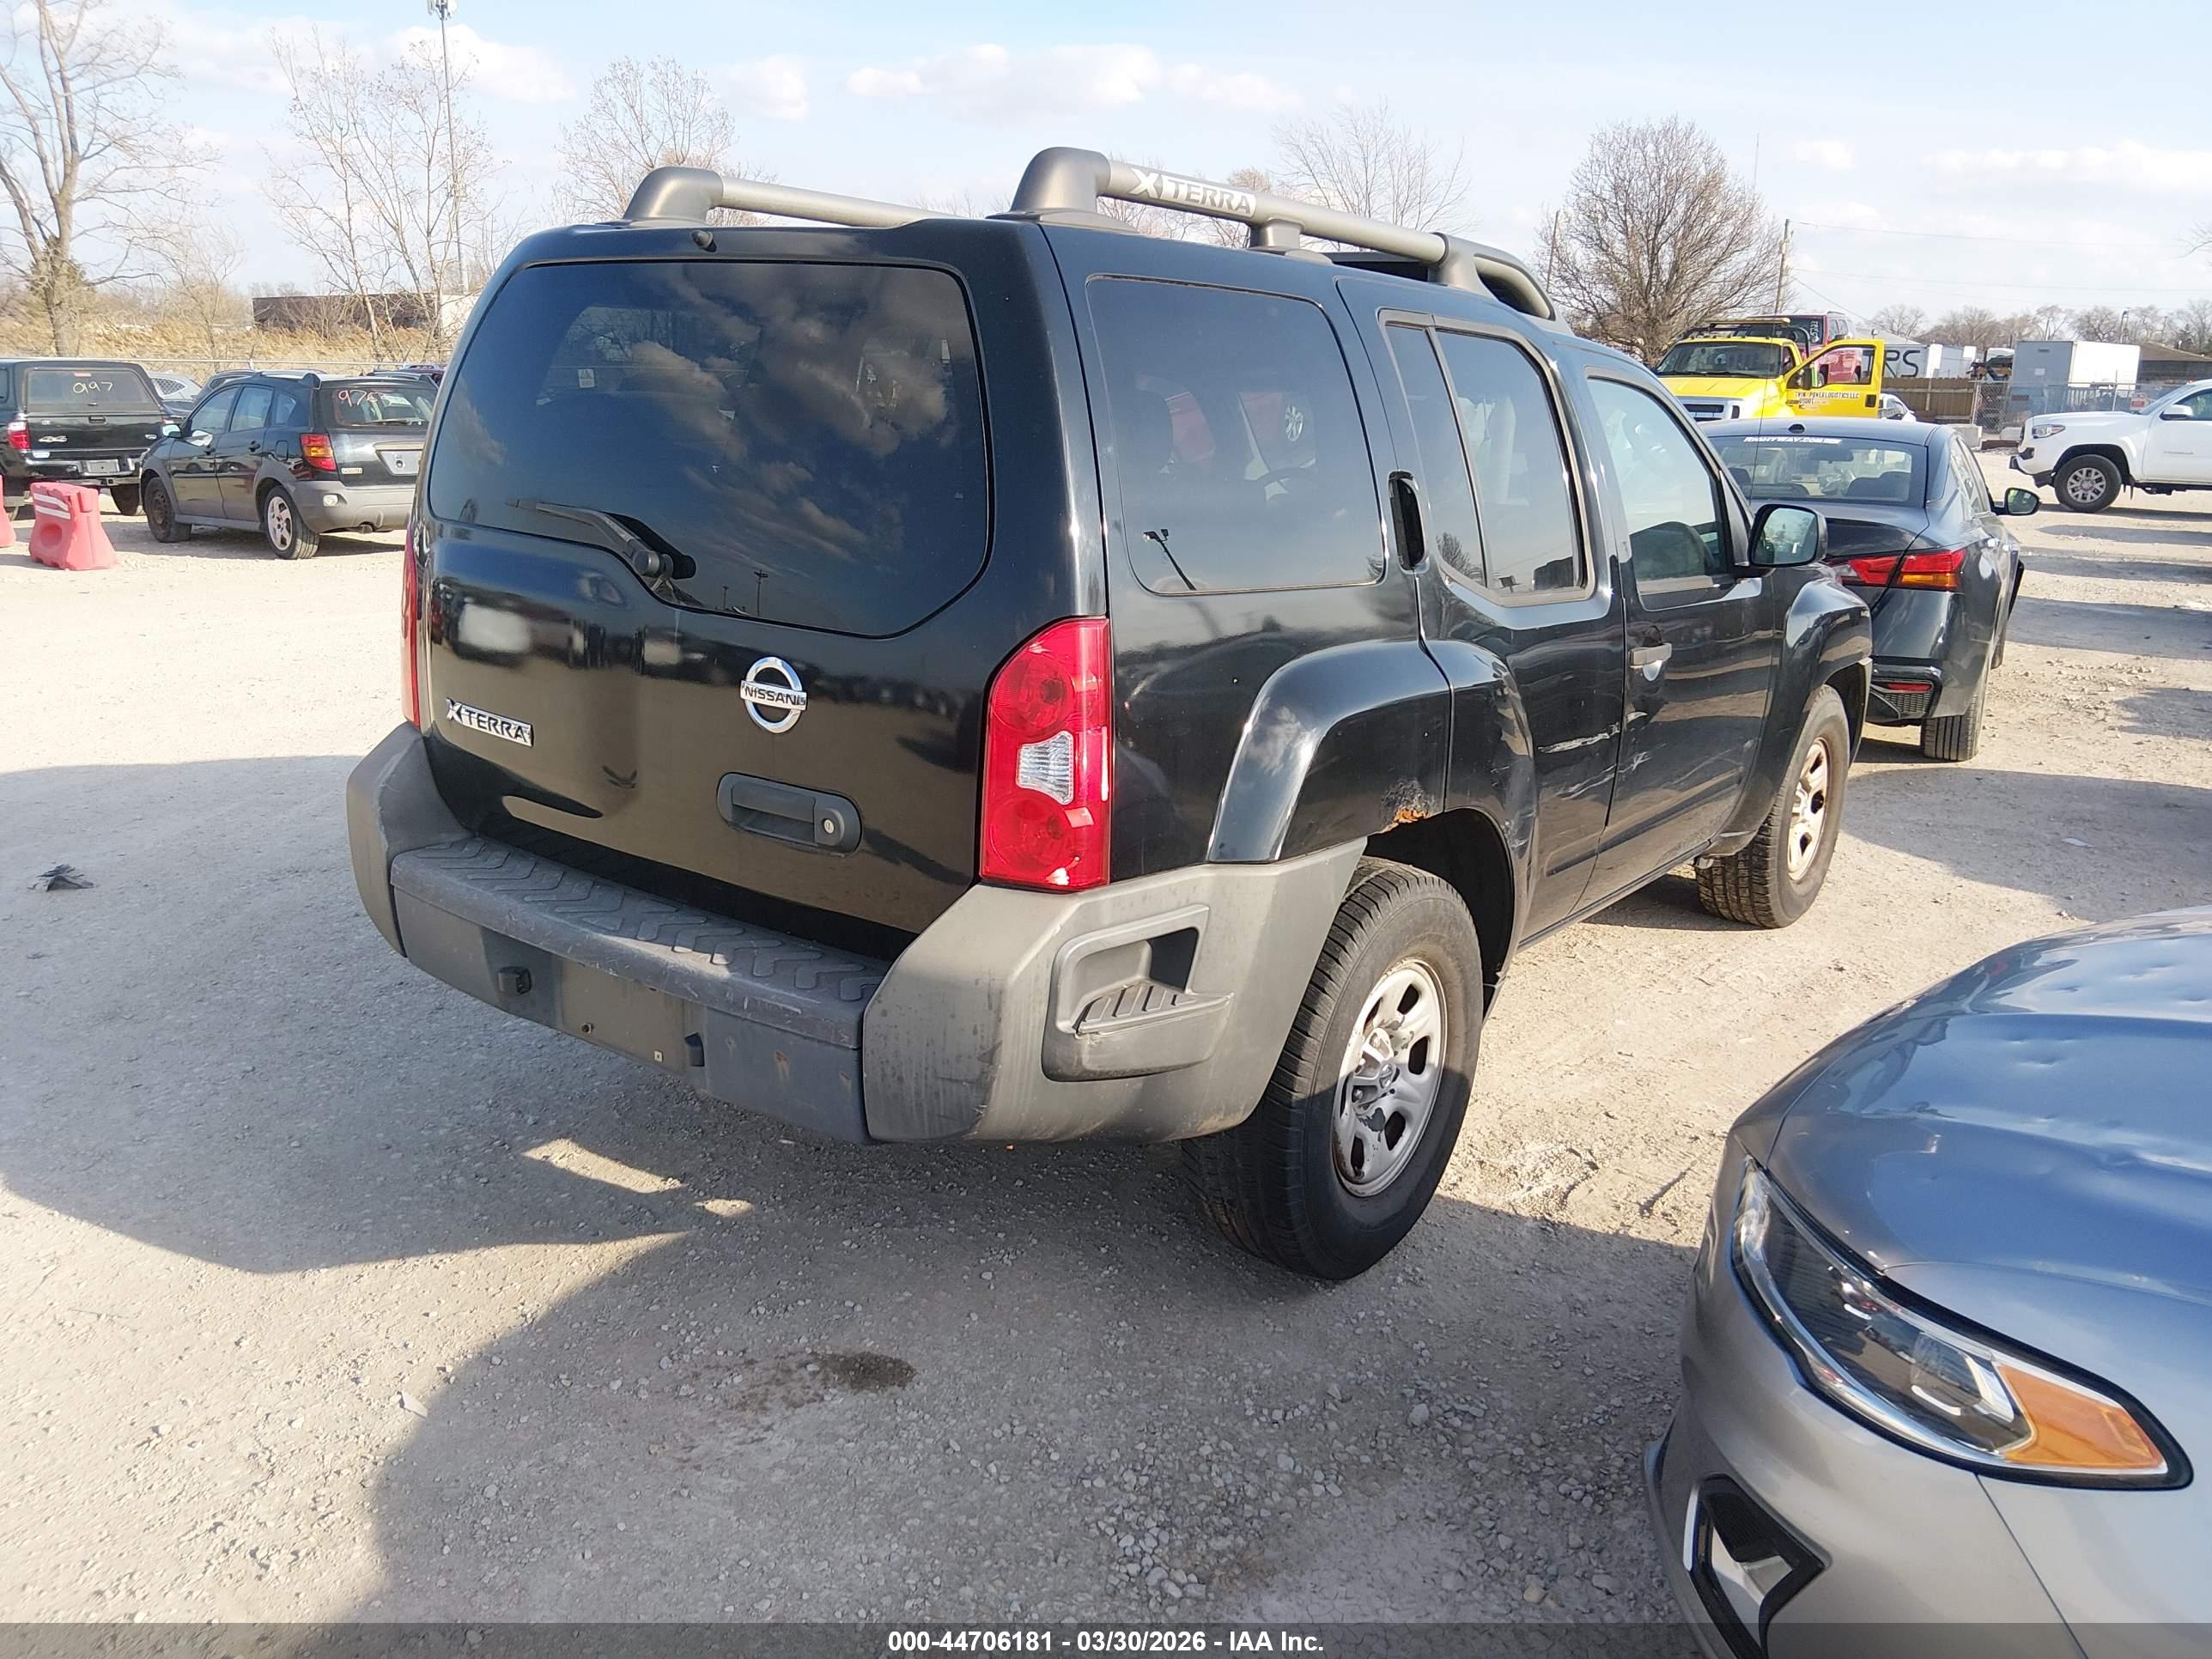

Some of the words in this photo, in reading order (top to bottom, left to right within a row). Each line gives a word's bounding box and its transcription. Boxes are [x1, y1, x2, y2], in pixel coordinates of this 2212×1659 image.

[1127, 167, 1257, 217] XTERRA
[744, 685, 797, 706] NISSAN
[446, 697, 533, 746] XTERRA
